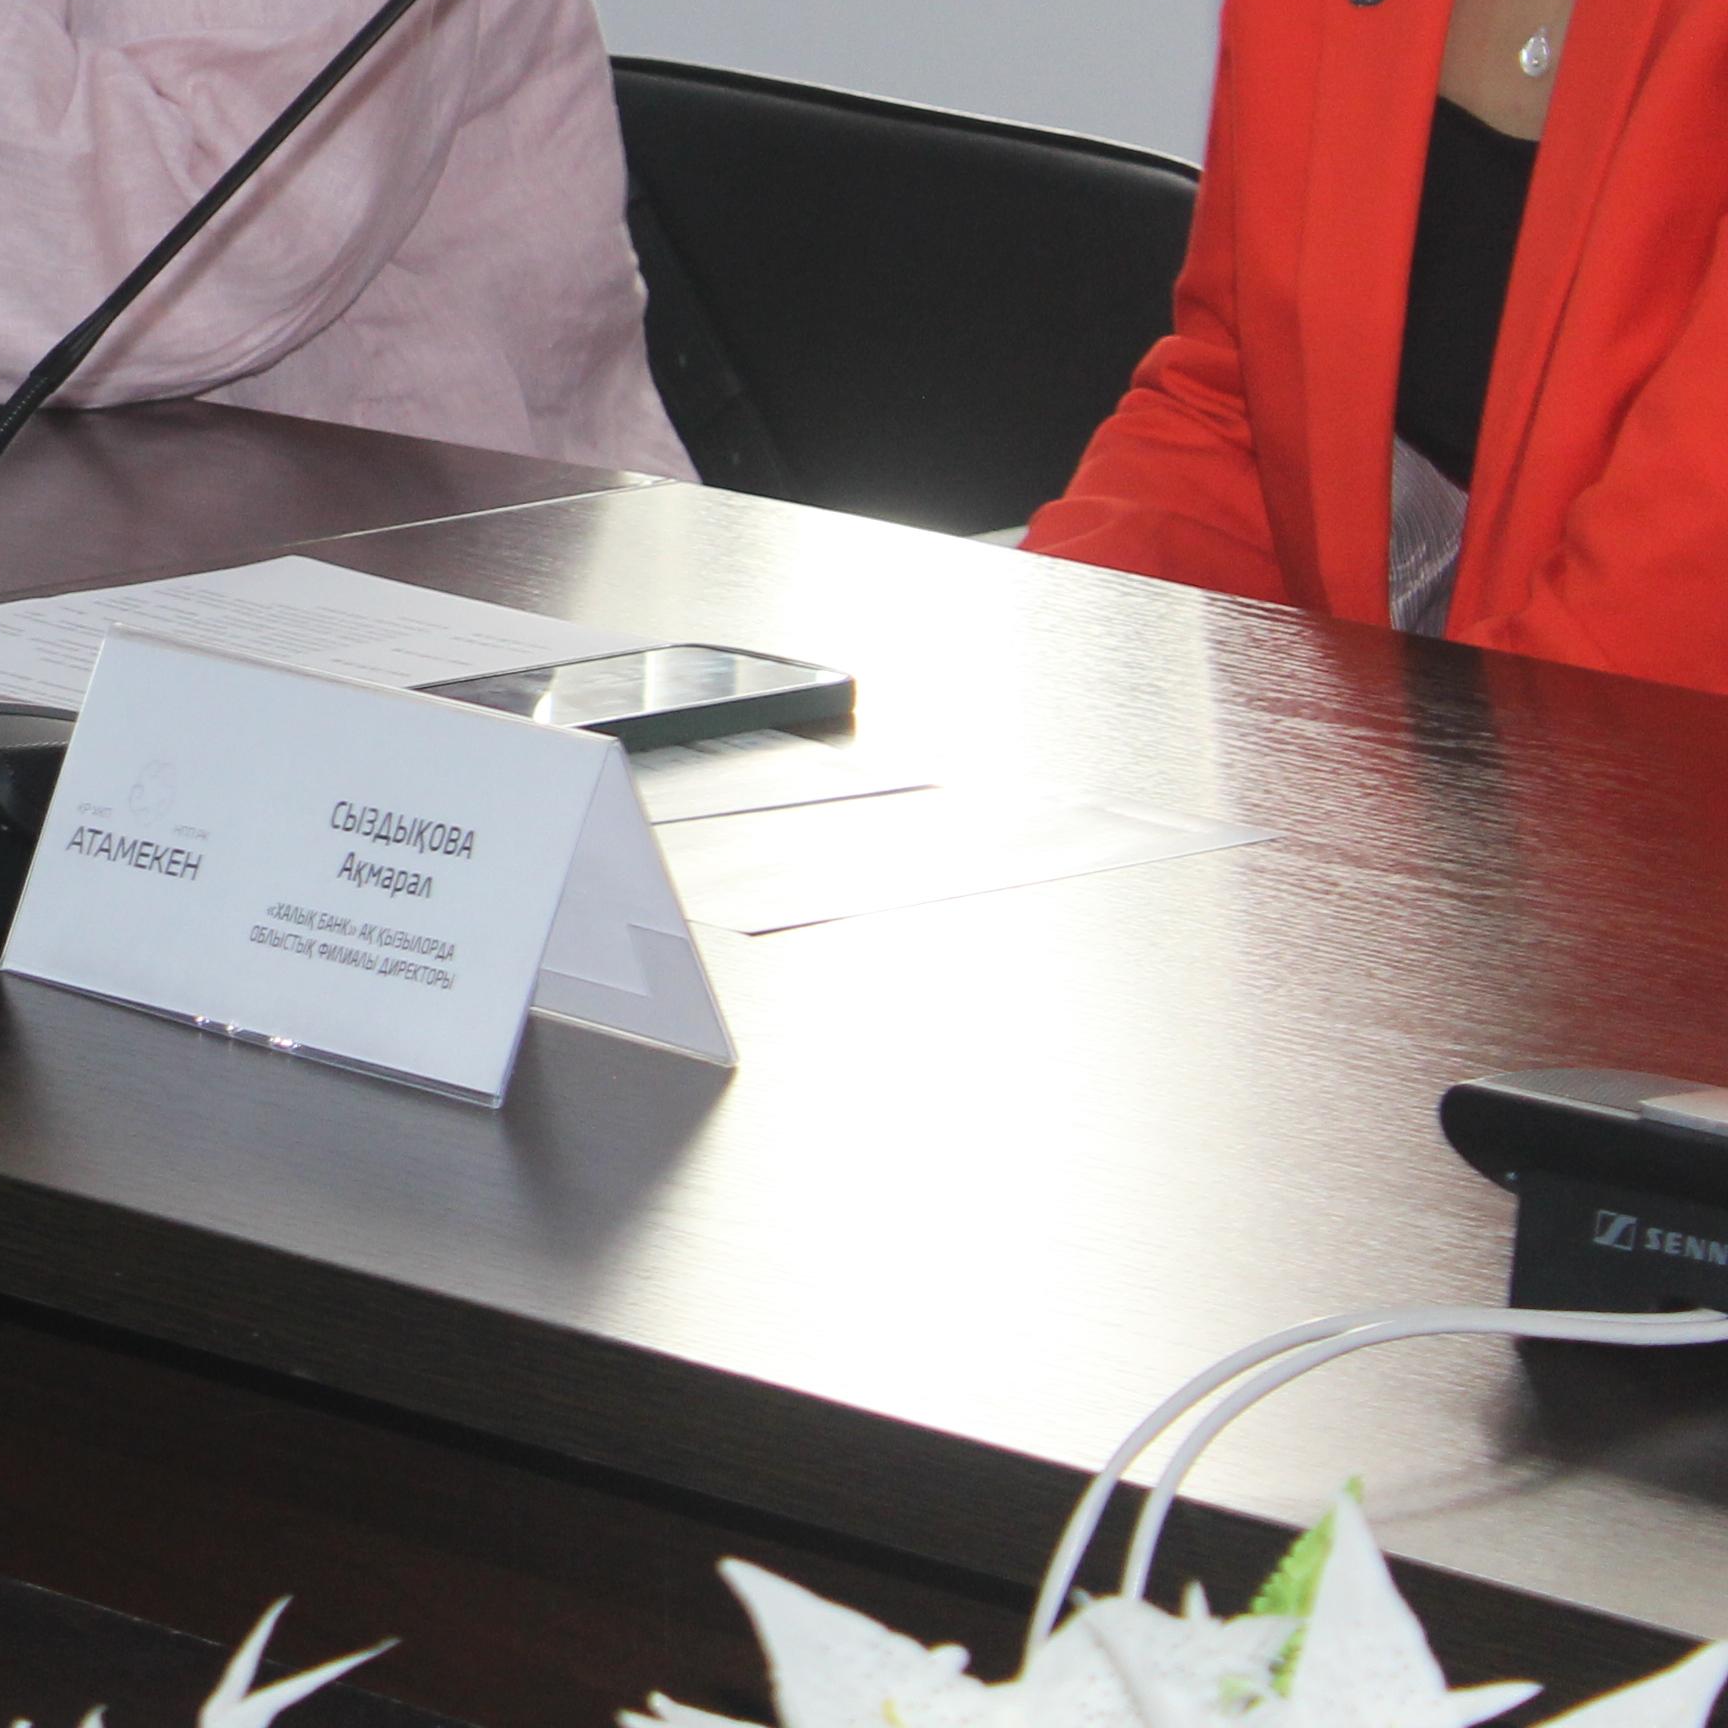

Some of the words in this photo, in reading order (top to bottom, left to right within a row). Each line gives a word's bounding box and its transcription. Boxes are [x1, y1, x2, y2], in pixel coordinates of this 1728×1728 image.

[66, 826, 203, 881] АТАМЕКЕН
[330, 801, 475, 859] СЫЗДЫҚОВА
[337, 851, 433, 898] Ақмарал
